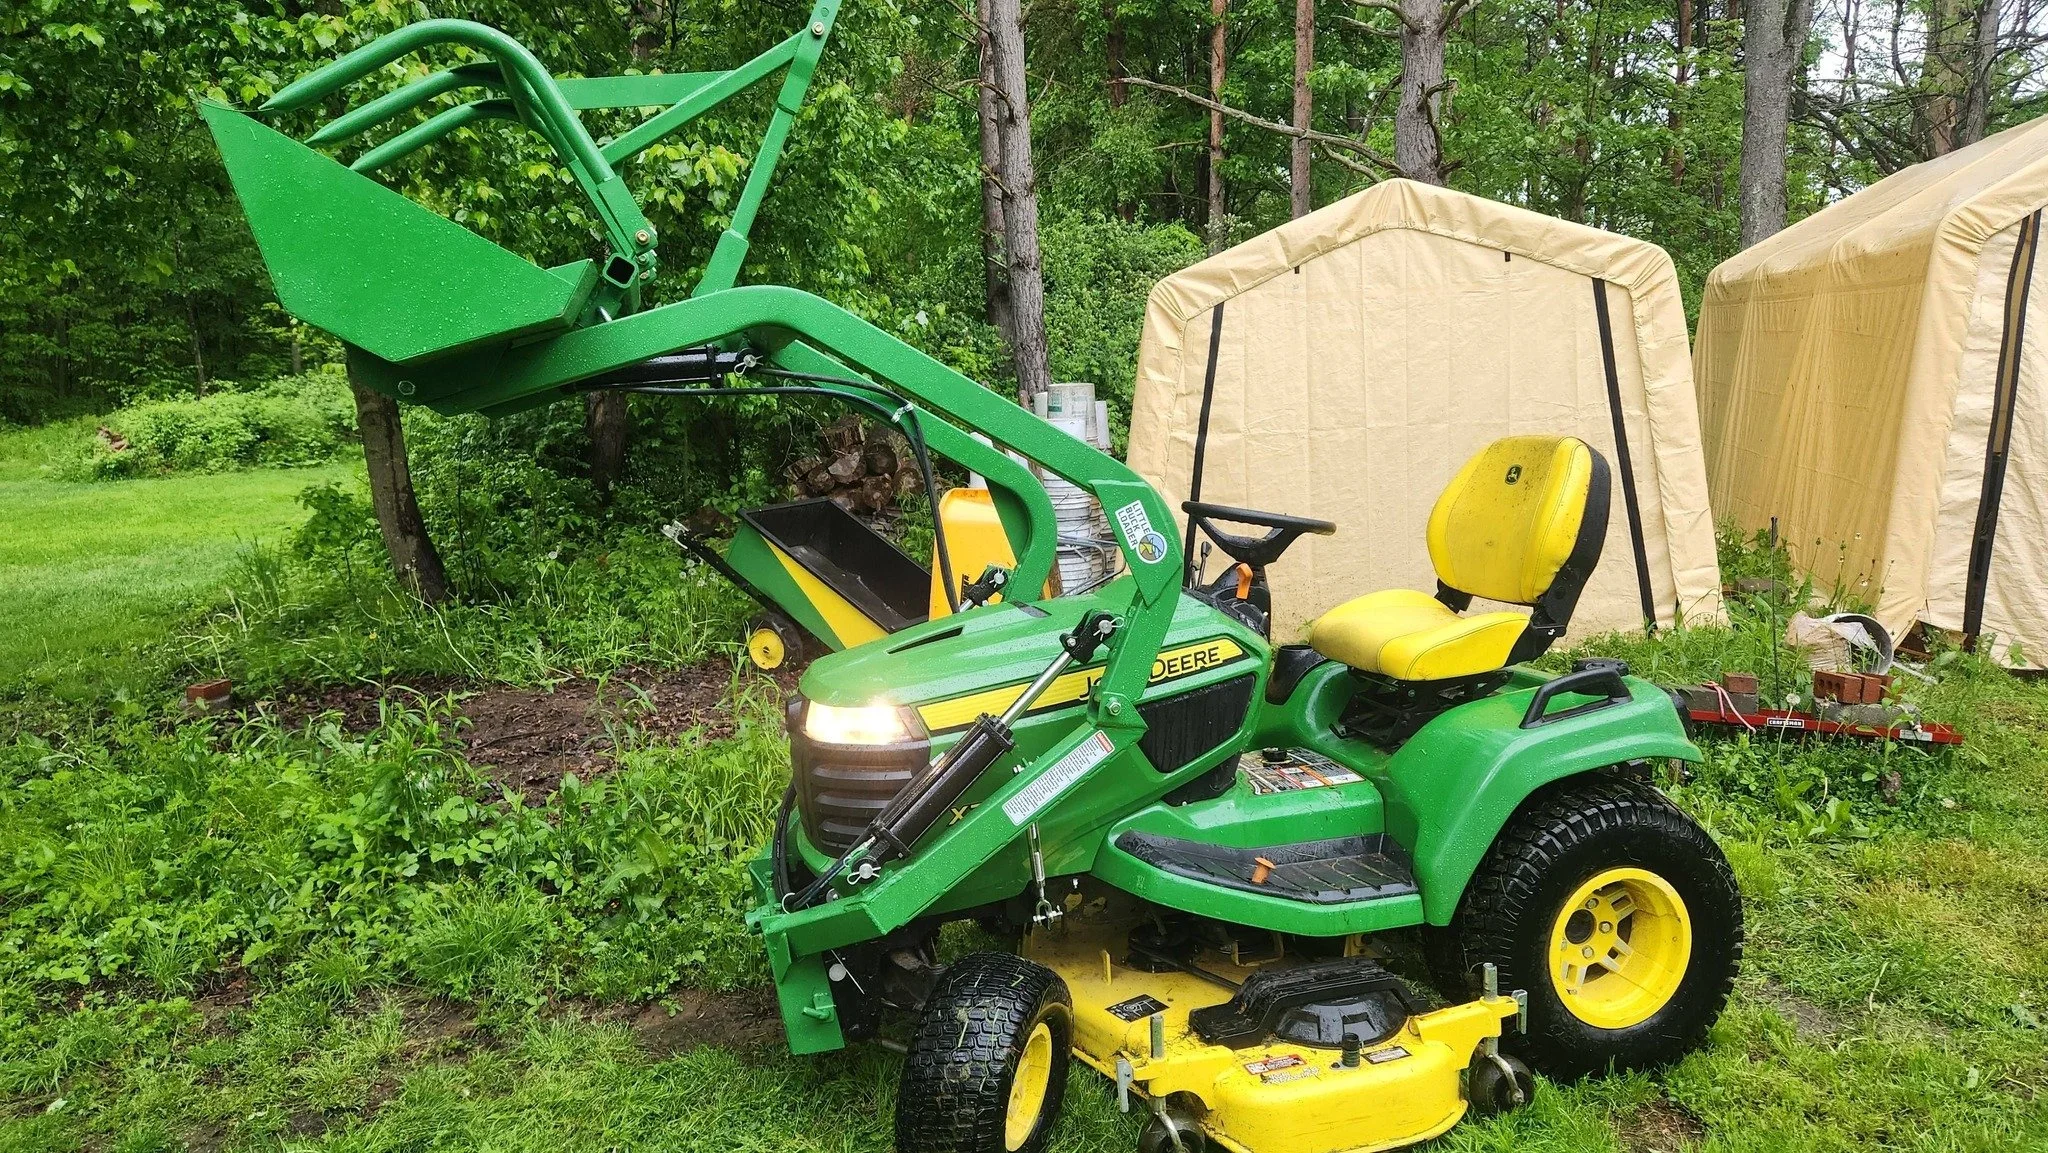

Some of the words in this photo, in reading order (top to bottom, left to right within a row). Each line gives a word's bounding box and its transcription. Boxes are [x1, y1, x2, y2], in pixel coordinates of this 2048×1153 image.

[1117, 510, 1139, 547] LOADER
[1125, 506, 1141, 532] BUCK
[1132, 502, 1151, 534] LITTLE
[1150, 646, 1221, 678] DEERE
